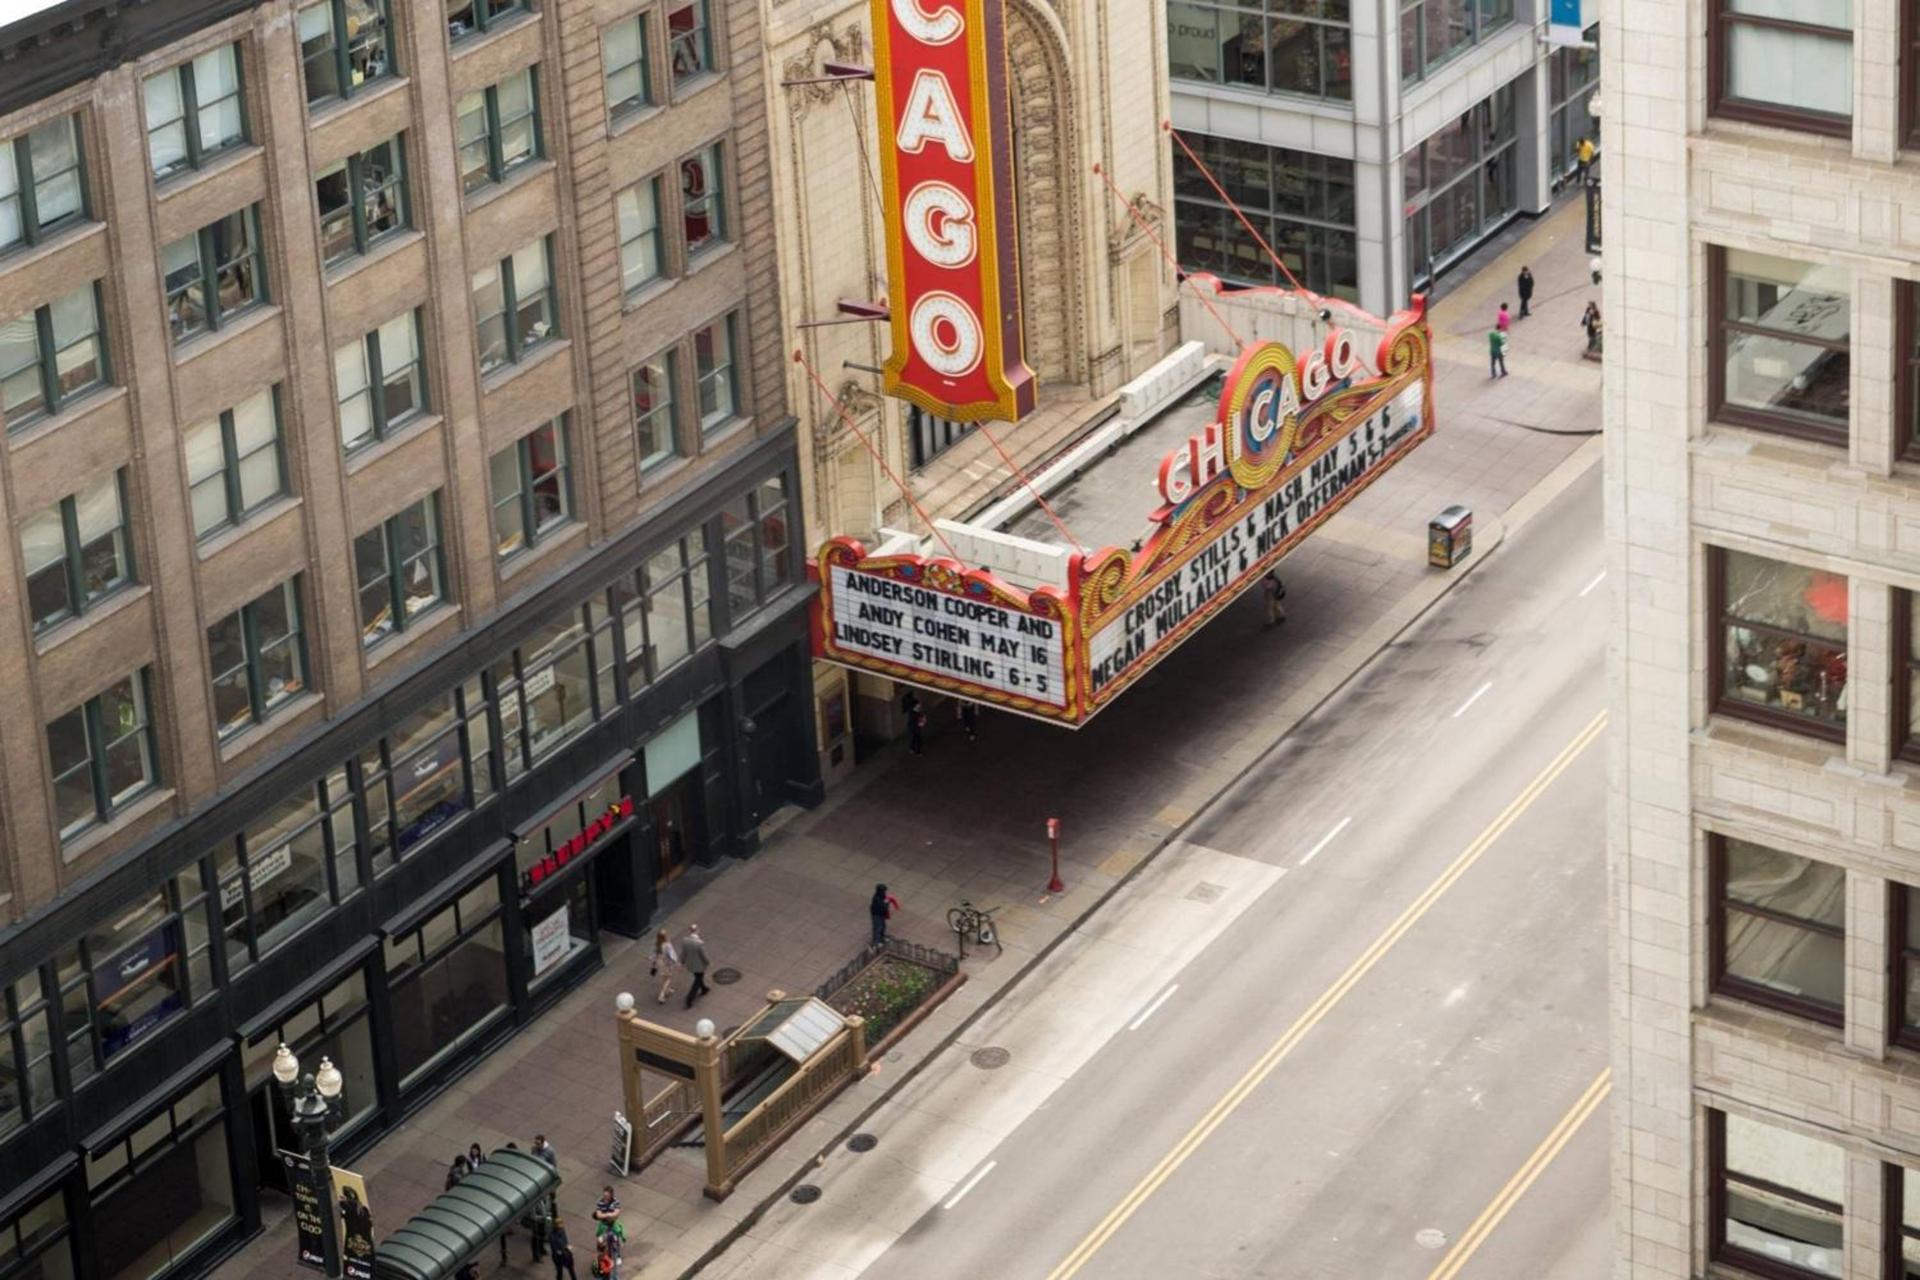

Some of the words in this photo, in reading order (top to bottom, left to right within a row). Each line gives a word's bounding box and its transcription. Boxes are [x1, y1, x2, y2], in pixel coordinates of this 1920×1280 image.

[1164, 328, 1357, 504] CHICAGO
[1091, 628, 1145, 693] MEGAN
[1156, 560, 1230, 639] MULLALLY
[1256, 513, 1289, 558] NICK
[1297, 449, 1366, 524] OFFERMAN
[1124, 571, 1183, 635] CROSBY
[1190, 526, 1240, 584] STILLS
[1265, 475, 1303, 525] NASH
[1311, 446, 1339, 488] MAY
[1349, 432, 1357, 456] 5
[1382, 405, 1390, 429] 6
[833, 620, 903, 655] LINDSEY
[912, 642, 994, 679] STIRLING
[846, 572, 938, 611] ANDERSON
[944, 597, 1009, 629] COOPER
[1017, 615, 1053, 639] AND
[858, 602, 904, 629] ANDY
[913, 616, 970, 646] COHEN
[980, 632, 1019, 658] MAY
[1031, 645, 1048, 665] 16
